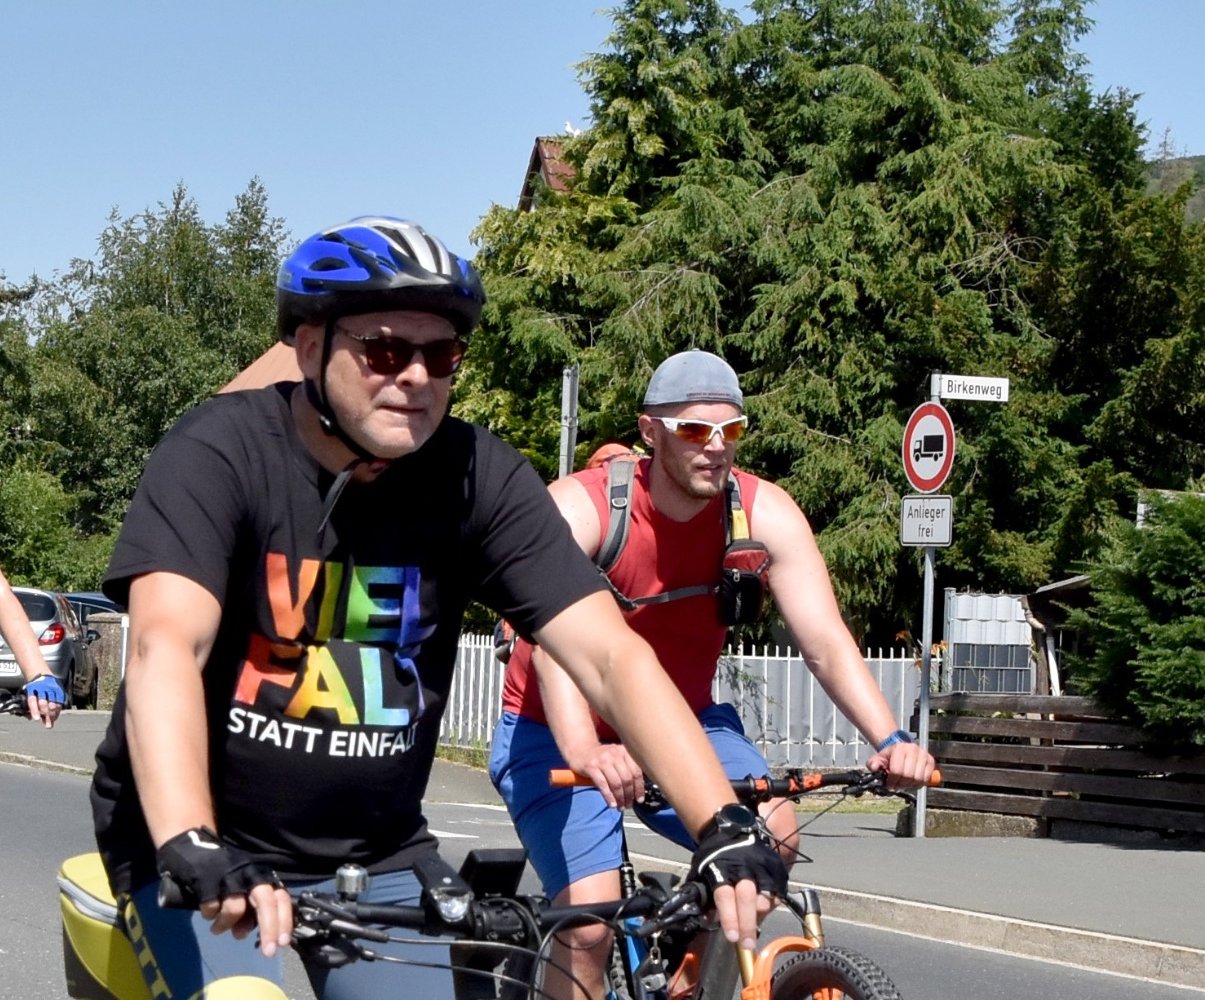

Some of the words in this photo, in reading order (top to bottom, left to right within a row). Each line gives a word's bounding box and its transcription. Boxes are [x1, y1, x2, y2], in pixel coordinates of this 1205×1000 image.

[947, 379, 1003, 400] Birkenweg
[907, 505, 946, 521] Anlieger
[917, 523, 934, 538] frei
[265, 552, 438, 649] VIEL
[228, 706, 323, 753] STATT
[121, 893, 173, 999] OTT
